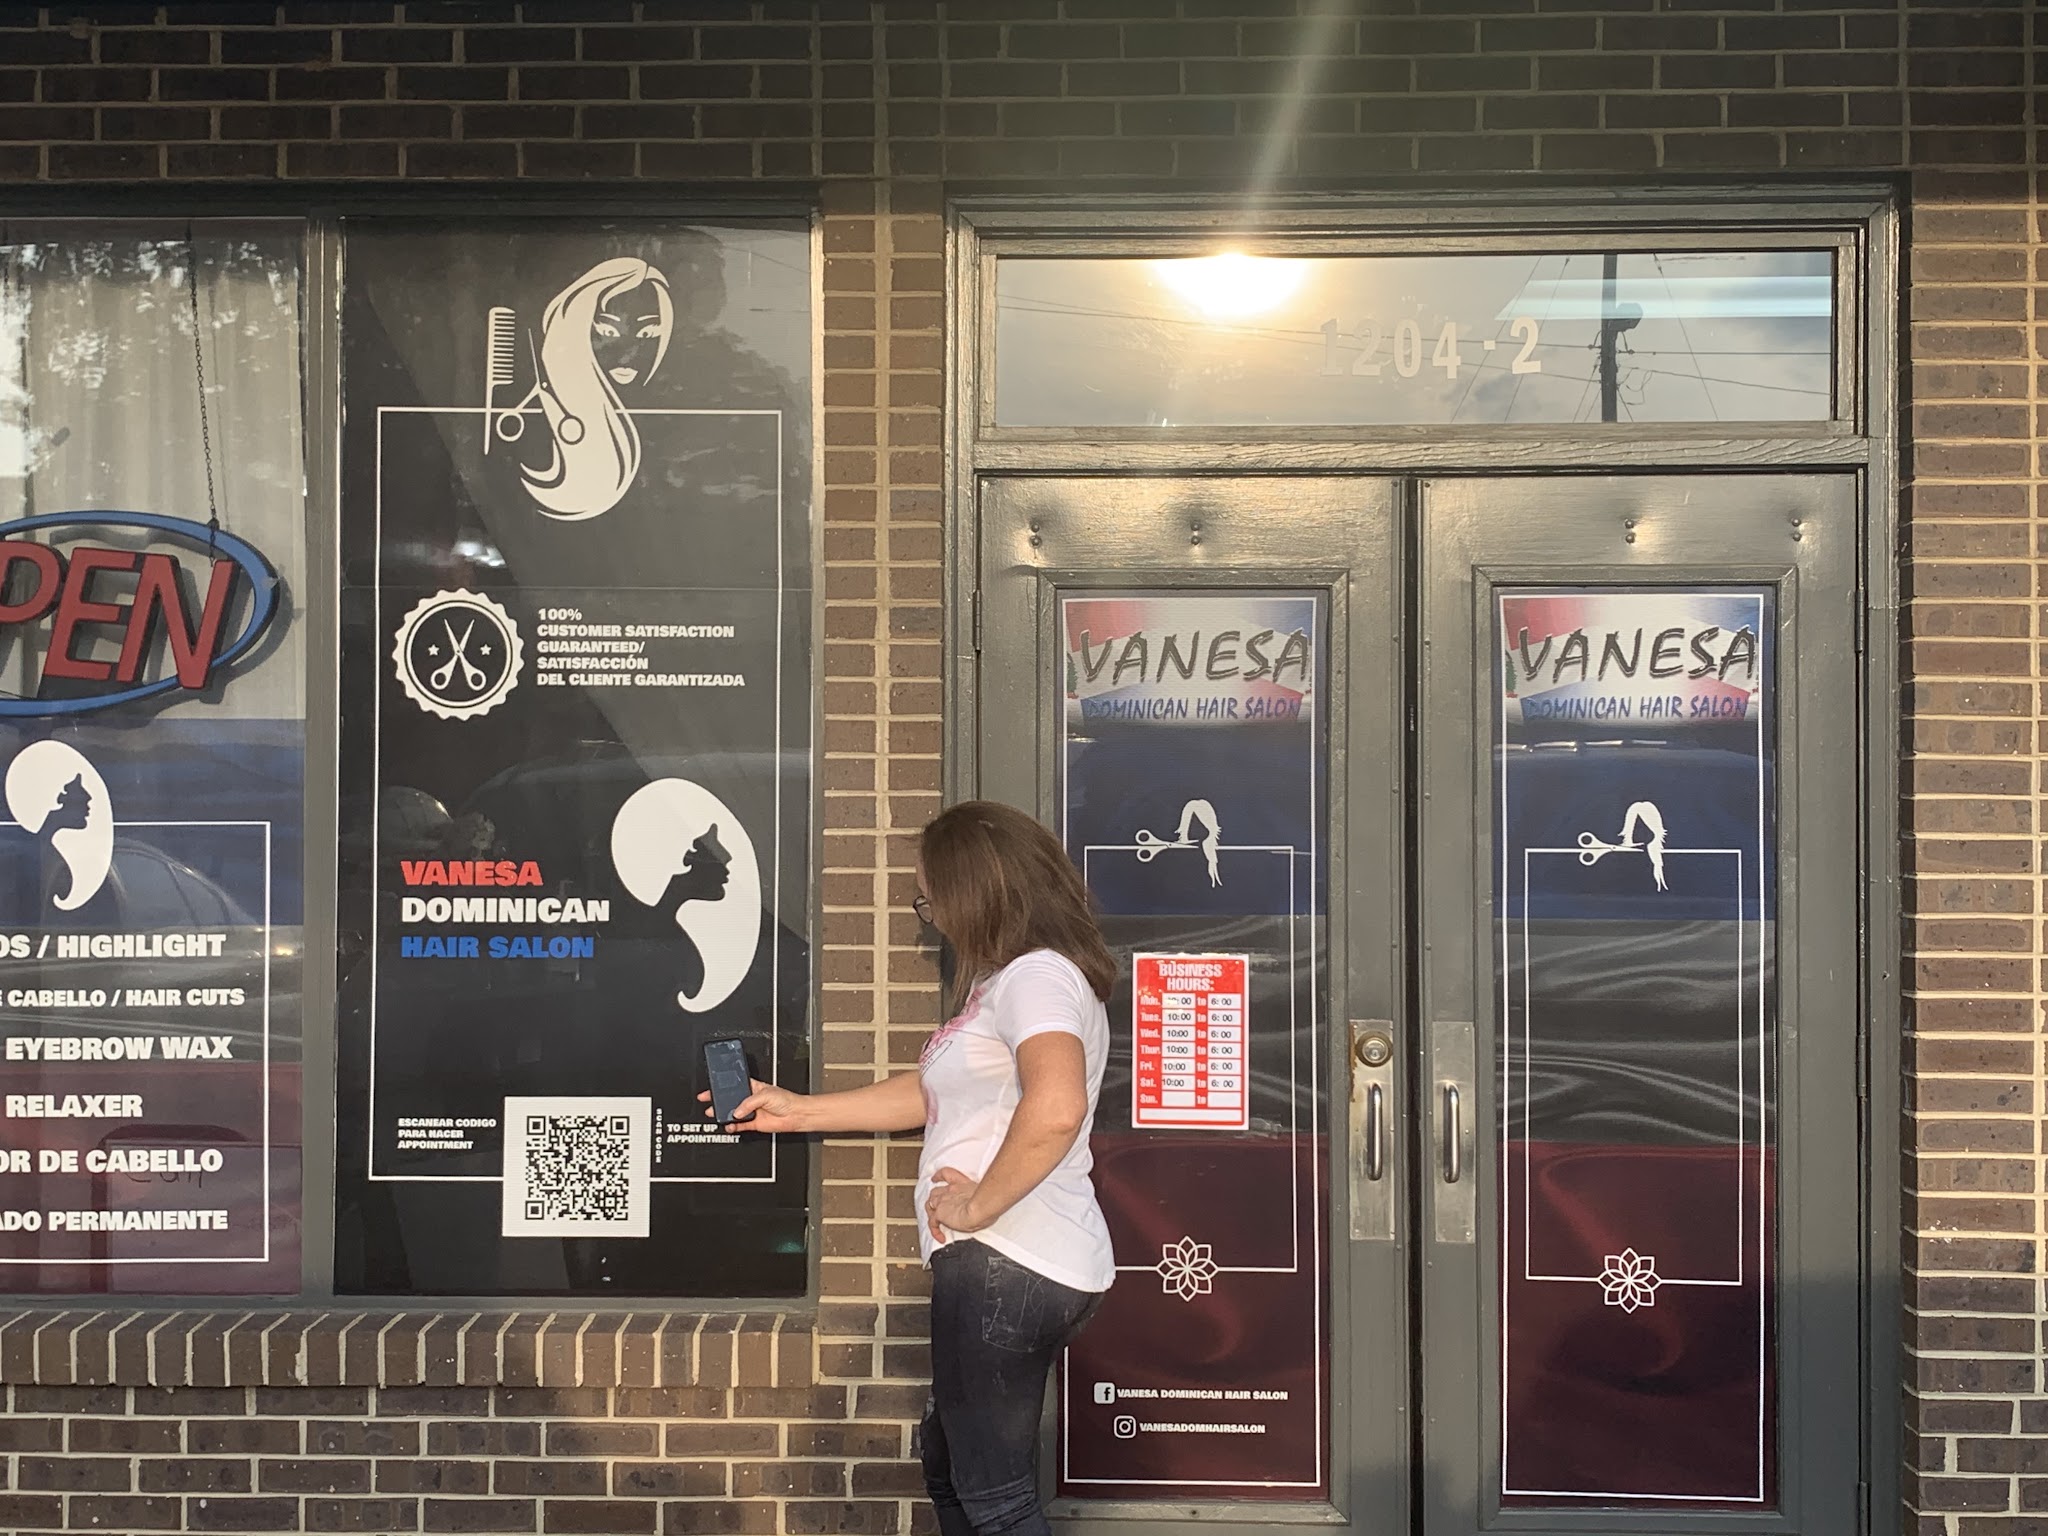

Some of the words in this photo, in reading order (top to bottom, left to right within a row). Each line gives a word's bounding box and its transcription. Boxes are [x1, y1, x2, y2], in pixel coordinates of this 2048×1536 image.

[538, 608, 582, 621] 100%
[537, 625, 622, 638] CUSTOMER
[624, 625, 735, 638] SATISFACTION
[537, 641, 645, 654] GUARANTEED/
[1519, 624, 1756, 683] VANESA
[1080, 627, 1310, 684] VANESA
[537, 655, 649, 670] SATISFACCIÓN
[537, 674, 565, 686] DEL
[568, 674, 631, 686] CLIENTE
[634, 674, 745, 686] GARANTIZADA
[1087, 697, 1188, 720] DOMINICAN
[1196, 697, 1238, 719] HAIR
[1245, 697, 1300, 719] SALON
[1526, 697, 1632, 720] DOMINICAN
[1640, 696, 1683, 718] HAIR
[1690, 695, 1749, 718] SALON
[401, 860, 543, 886] VANESA
[401, 897, 610, 922] DOMINICAN
[57, 934, 226, 958] HIGHLIGHT
[401, 936, 480, 958] HAIR
[488, 936, 595, 959] SALON
[1159, 963, 1222, 977] BUSINESS
[1167, 978, 1214, 991] HOURS:
[8, 989, 106, 1008] CABELLO
[125, 989, 181, 1007] HAIR
[186, 988, 245, 1006] CUTS
[1167, 997, 1191, 1005] :00
[1197, 998, 1206, 1006] to
[1197, 1014, 1206, 1022] to
[1197, 1031, 1206, 1039] to
[6, 1036, 154, 1060] EYEBROW
[160, 1036, 233, 1059] WAX
[1167, 1046, 1188, 1054] 10:00
[1197, 1046, 1206, 1054] to
[1197, 1063, 1206, 1071] to
[1140, 1078, 1156, 1087] Sat.
[1197, 1080, 1206, 1088] to
[1140, 1094, 1158, 1103] Sun.
[1197, 1096, 1206, 1104] to
[6, 1095, 143, 1118] RELAXER
[398, 1118, 454, 1127] ESCANEAR
[455, 1118, 497, 1127] CODIGO
[667, 1124, 681, 1132] TO
[682, 1124, 701, 1132] SET
[703, 1124, 718, 1132] UP
[398, 1129, 427, 1138] PARA
[667, 1135, 740, 1143] APPOINTMENT
[397, 1140, 474, 1149] APPOINTMENT
[39, 1149, 78, 1173] DE
[85, 1149, 224, 1173] CABELLO
[0, 1210, 42, 1232] DO
[48, 1210, 228, 1231] PERMANENTE
[1117, 1389, 1159, 1398] VANESA
[1160, 1389, 1223, 1399] DOMINICAN
[1225, 1390, 1251, 1399] HAIR
[1253, 1390, 1288, 1400] SALON
[1139, 1422, 1265, 1433] VANESADOMHAIRSALON
